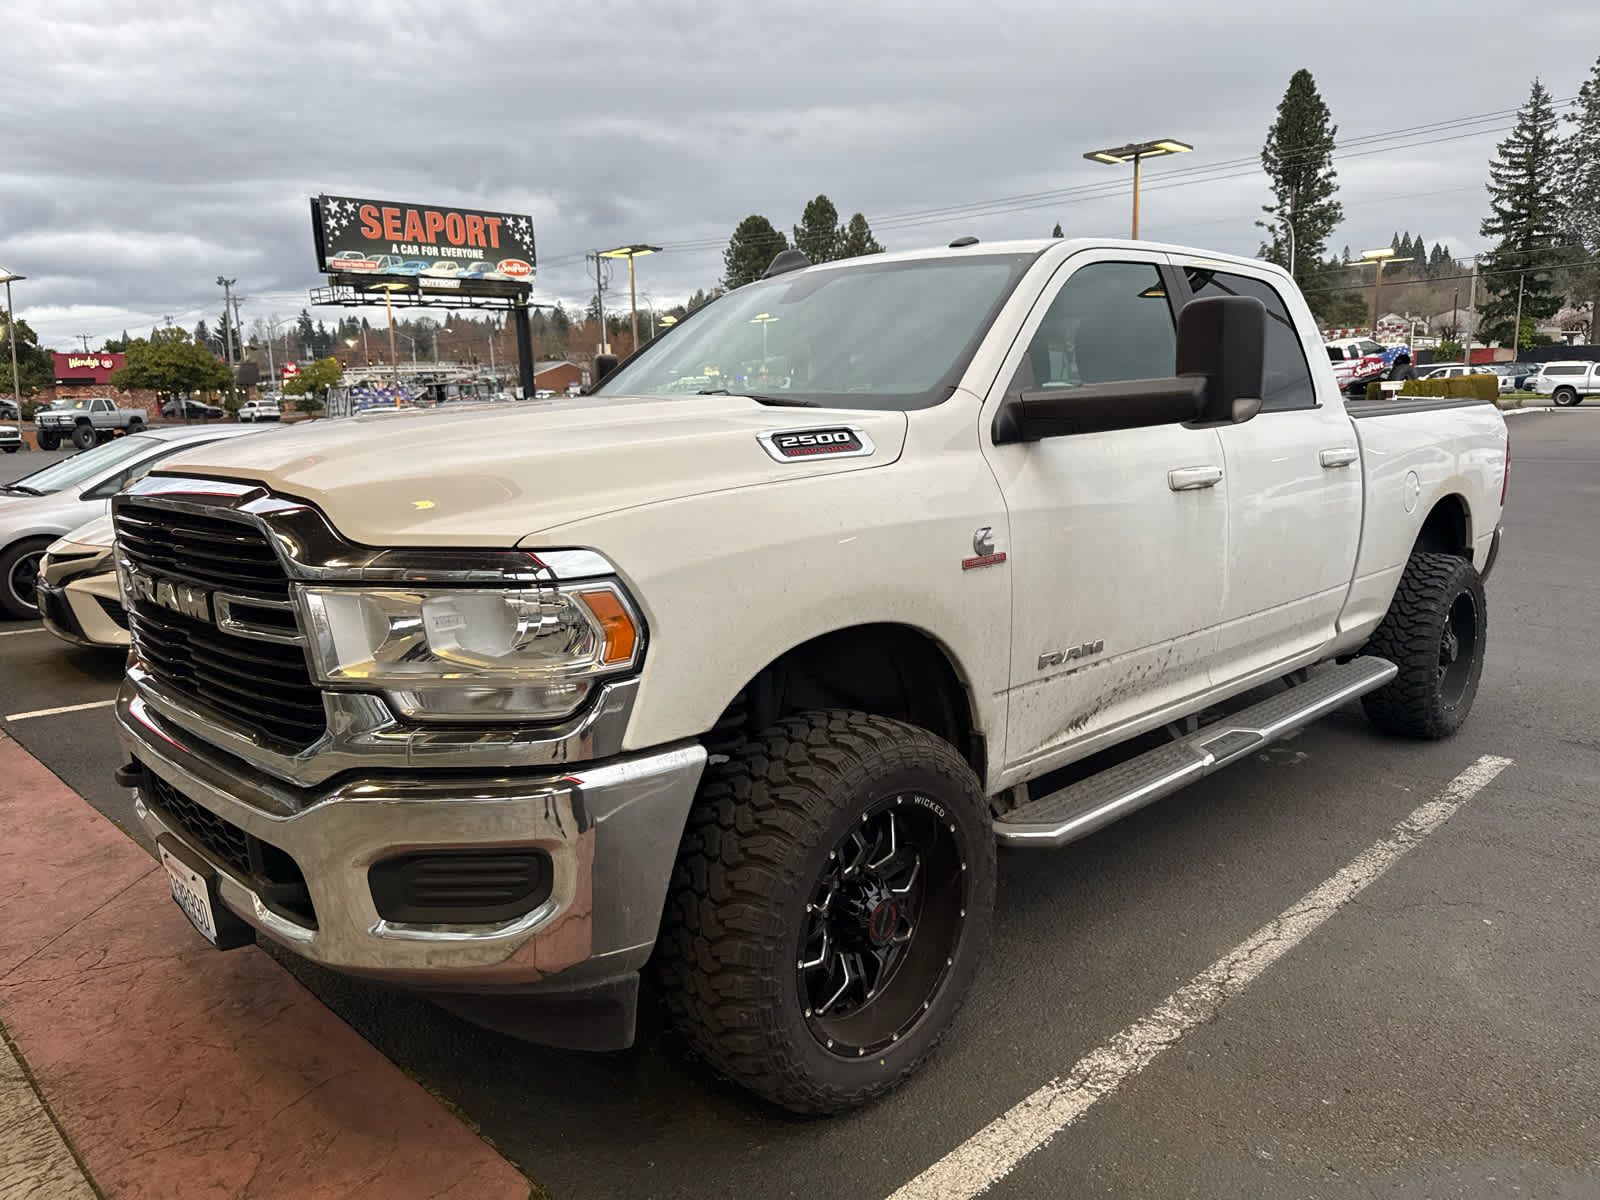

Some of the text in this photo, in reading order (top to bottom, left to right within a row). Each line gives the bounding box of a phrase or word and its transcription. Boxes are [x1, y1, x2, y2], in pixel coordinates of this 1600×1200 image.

[359, 204, 502, 248] SEAPORT
[391, 243, 484, 260] A CAR FOR EVERYONE
[68, 356, 99, 369] Wendy's
[781, 432, 850, 447] 2500
[1038, 640, 1104, 671] RAM
[914, 794, 945, 817] WICKED
